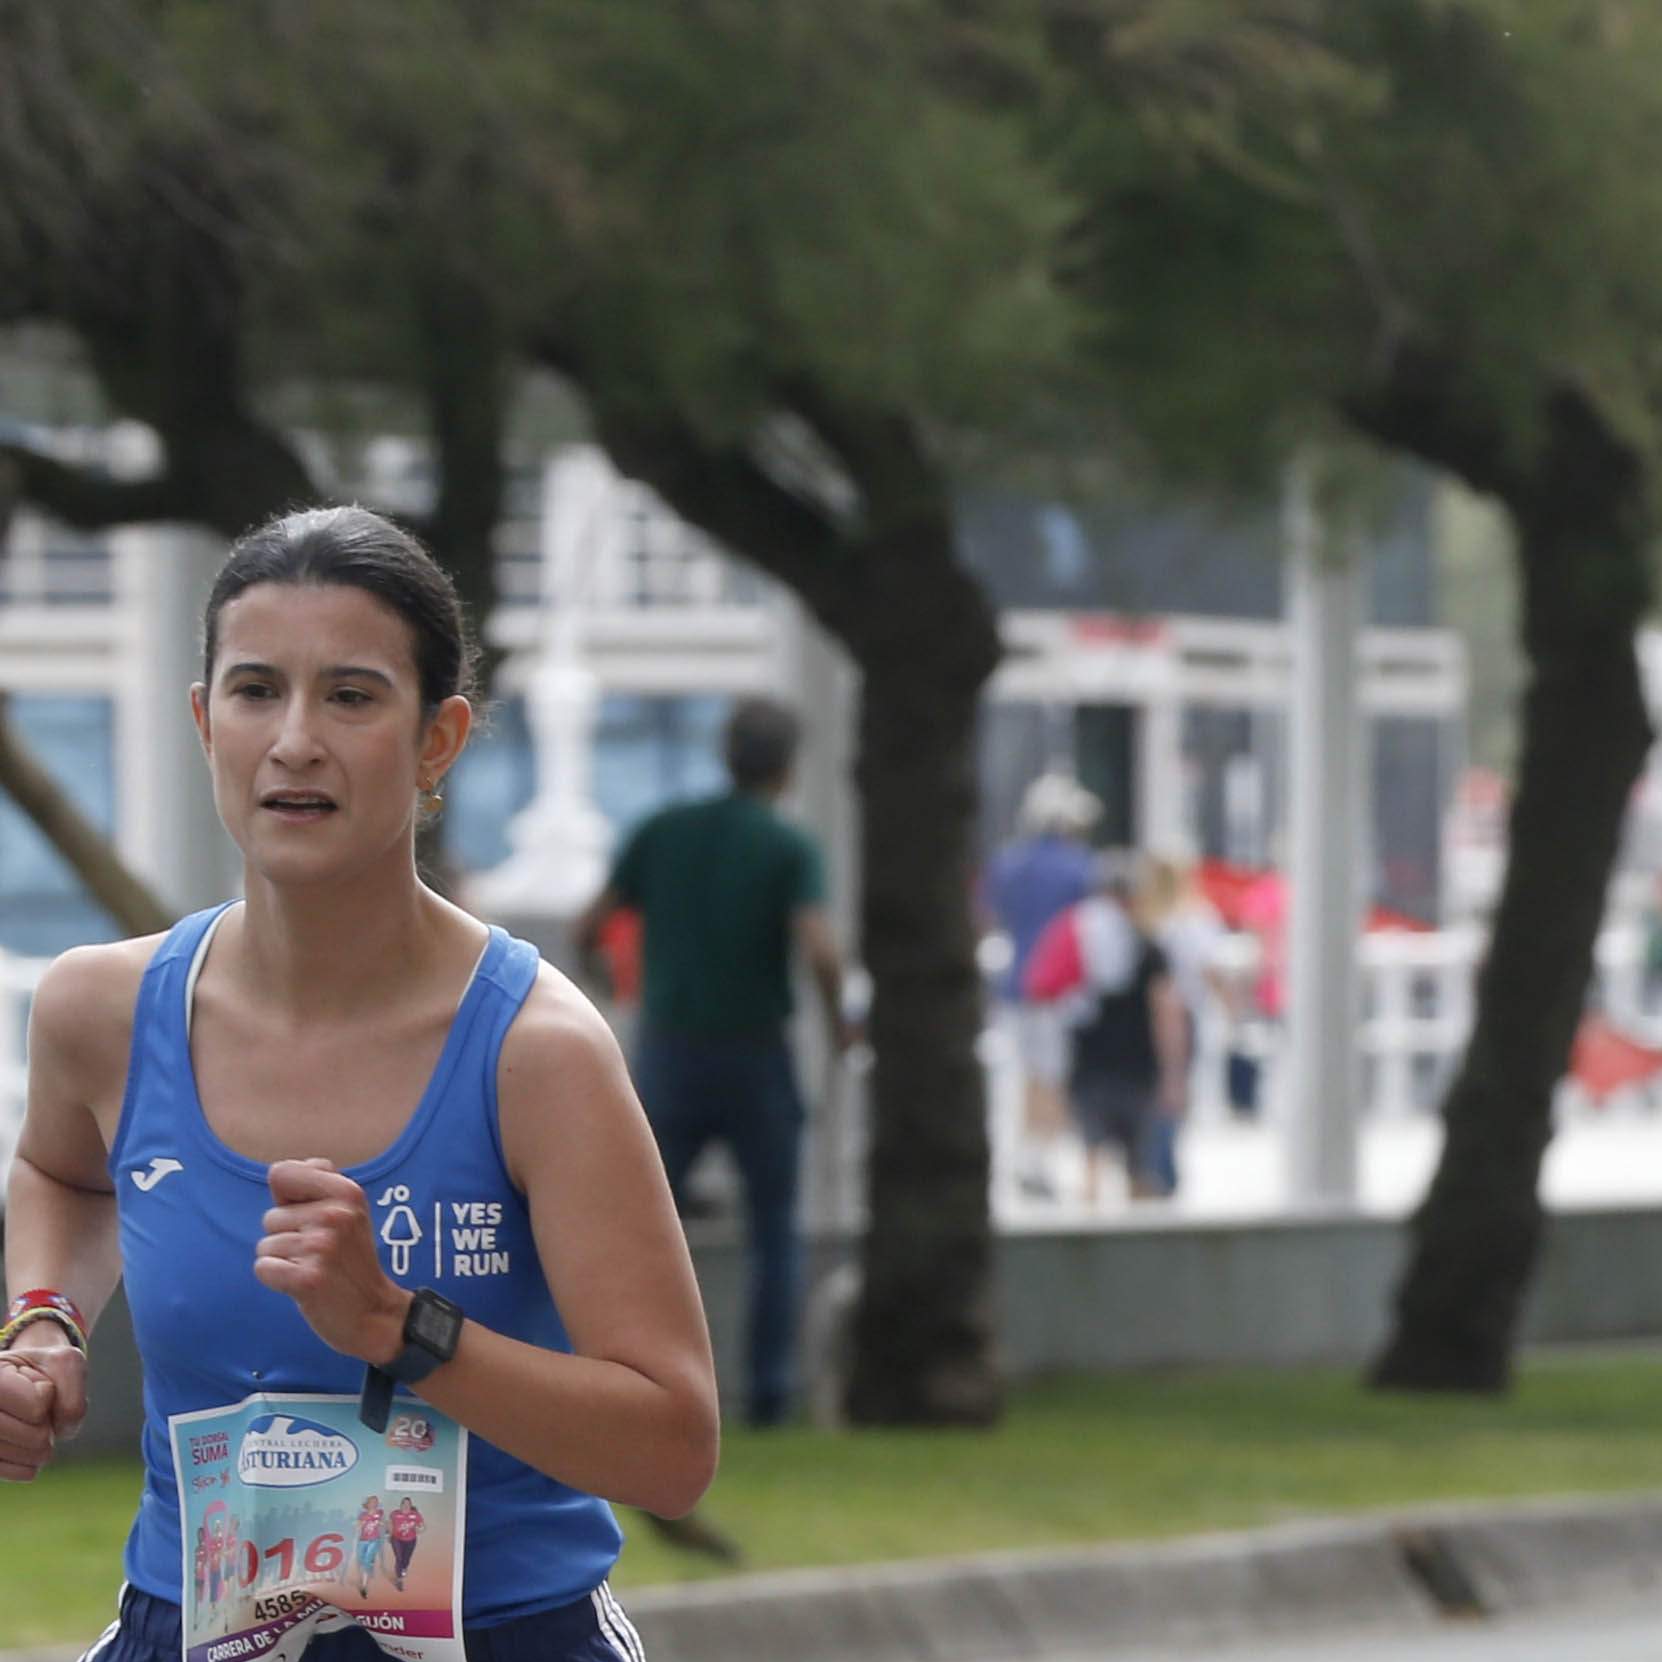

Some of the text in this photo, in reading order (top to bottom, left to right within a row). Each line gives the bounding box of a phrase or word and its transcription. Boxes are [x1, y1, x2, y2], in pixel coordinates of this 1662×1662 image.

[452, 1203, 502, 1225] YES
[452, 1229, 496, 1250] WE
[454, 1252, 509, 1276] RUN
[192, 1445, 228, 1465] SUMA
[207, 1639, 253, 1662] CARRERA
[253, 1631, 273, 1648] DE
